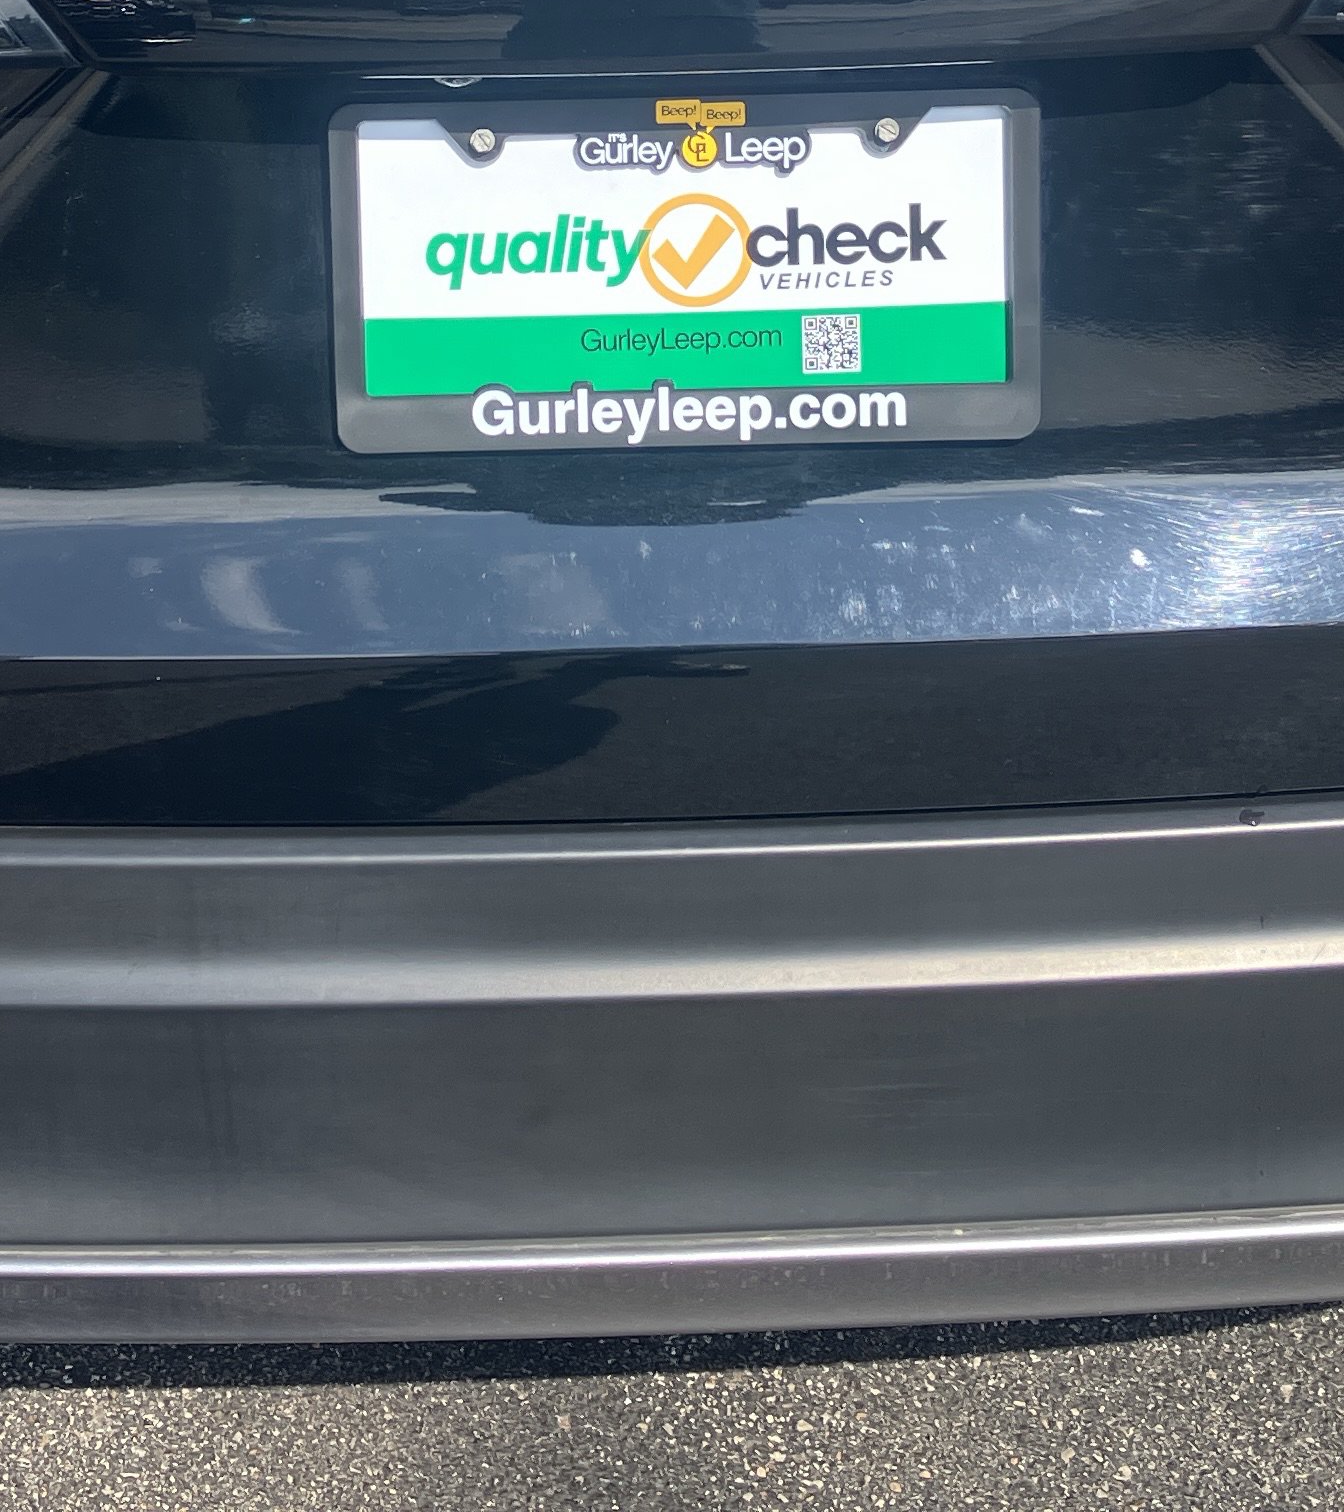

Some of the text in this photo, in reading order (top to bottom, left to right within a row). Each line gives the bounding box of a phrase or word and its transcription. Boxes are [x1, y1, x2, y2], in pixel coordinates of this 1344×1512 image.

[661, 105, 742, 120] Beep! Beep!
[580, 134, 674, 170] Gurley
[725, 132, 805, 169] Leep
[426, 203, 948, 291] quality check
[758, 269, 896, 291] VEHICLES
[580, 325, 783, 357] GurleyLeep.com
[472, 388, 908, 446] Gurleyleep.com
